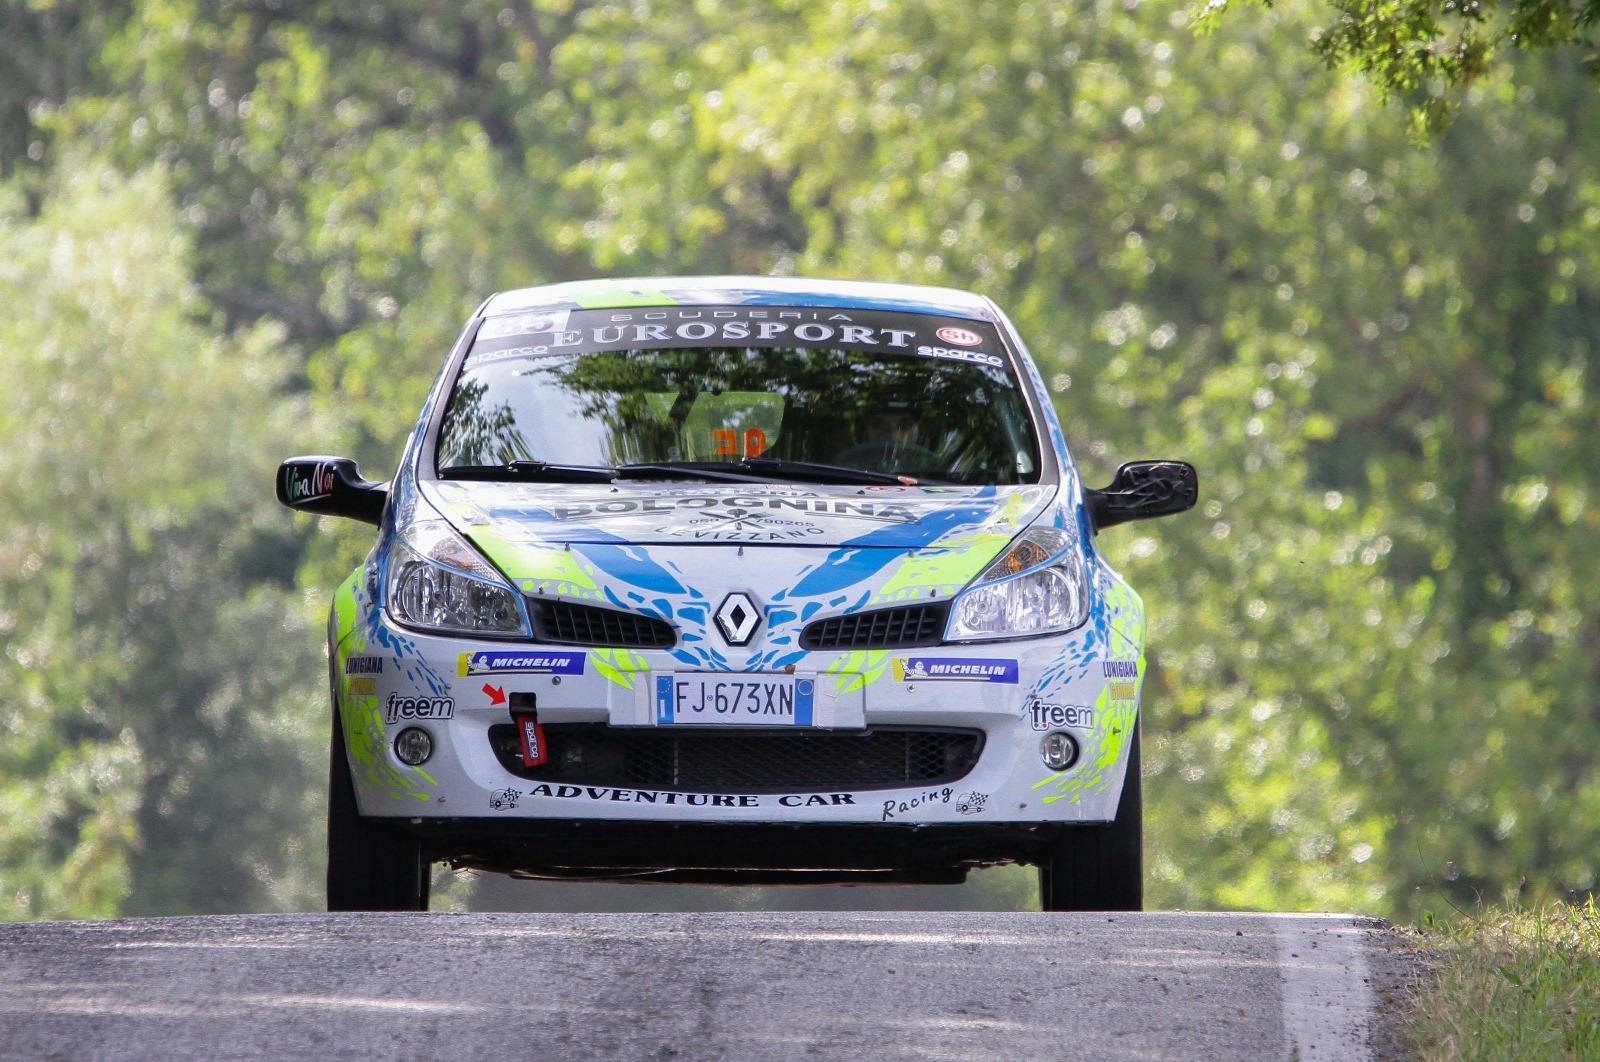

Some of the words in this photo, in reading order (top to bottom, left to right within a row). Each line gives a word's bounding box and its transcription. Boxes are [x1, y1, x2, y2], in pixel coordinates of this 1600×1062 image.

[610, 310, 853, 322] SCUDERIA
[550, 321, 916, 348] EUROSPORT
[916, 345, 1004, 368] sparco
[554, 497, 920, 521] BOLOGNINA
[491, 657, 571, 668] MICHELIN
[929, 664, 1006, 676] MICHELIN
[1102, 661, 1138, 678] LUNIGIANA
[387, 694, 454, 722] freem
[1030, 700, 1093, 728] freem
[524, 721, 540, 760] sparco
[529, 784, 759, 808] ADVENTURE
[778, 793, 857, 807] CAR
[881, 786, 954, 822] Racing
